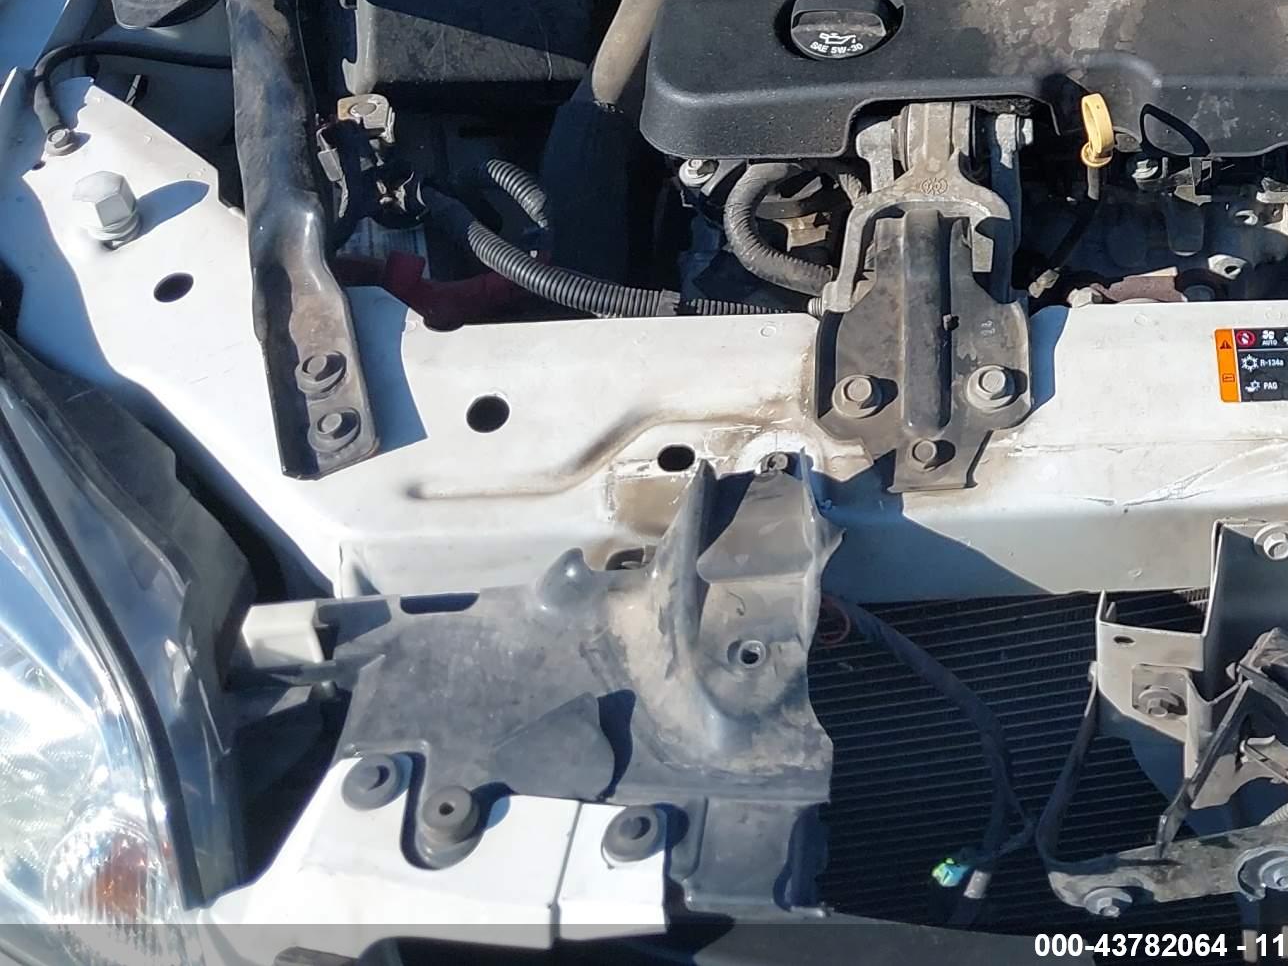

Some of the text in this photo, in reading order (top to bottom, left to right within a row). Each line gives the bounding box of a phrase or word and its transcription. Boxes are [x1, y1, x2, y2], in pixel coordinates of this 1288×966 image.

[810, 41, 864, 54] SAE 5W-30
[1260, 358, 1284, 367] R-134a
[1263, 381, 1278, 390] PAG
